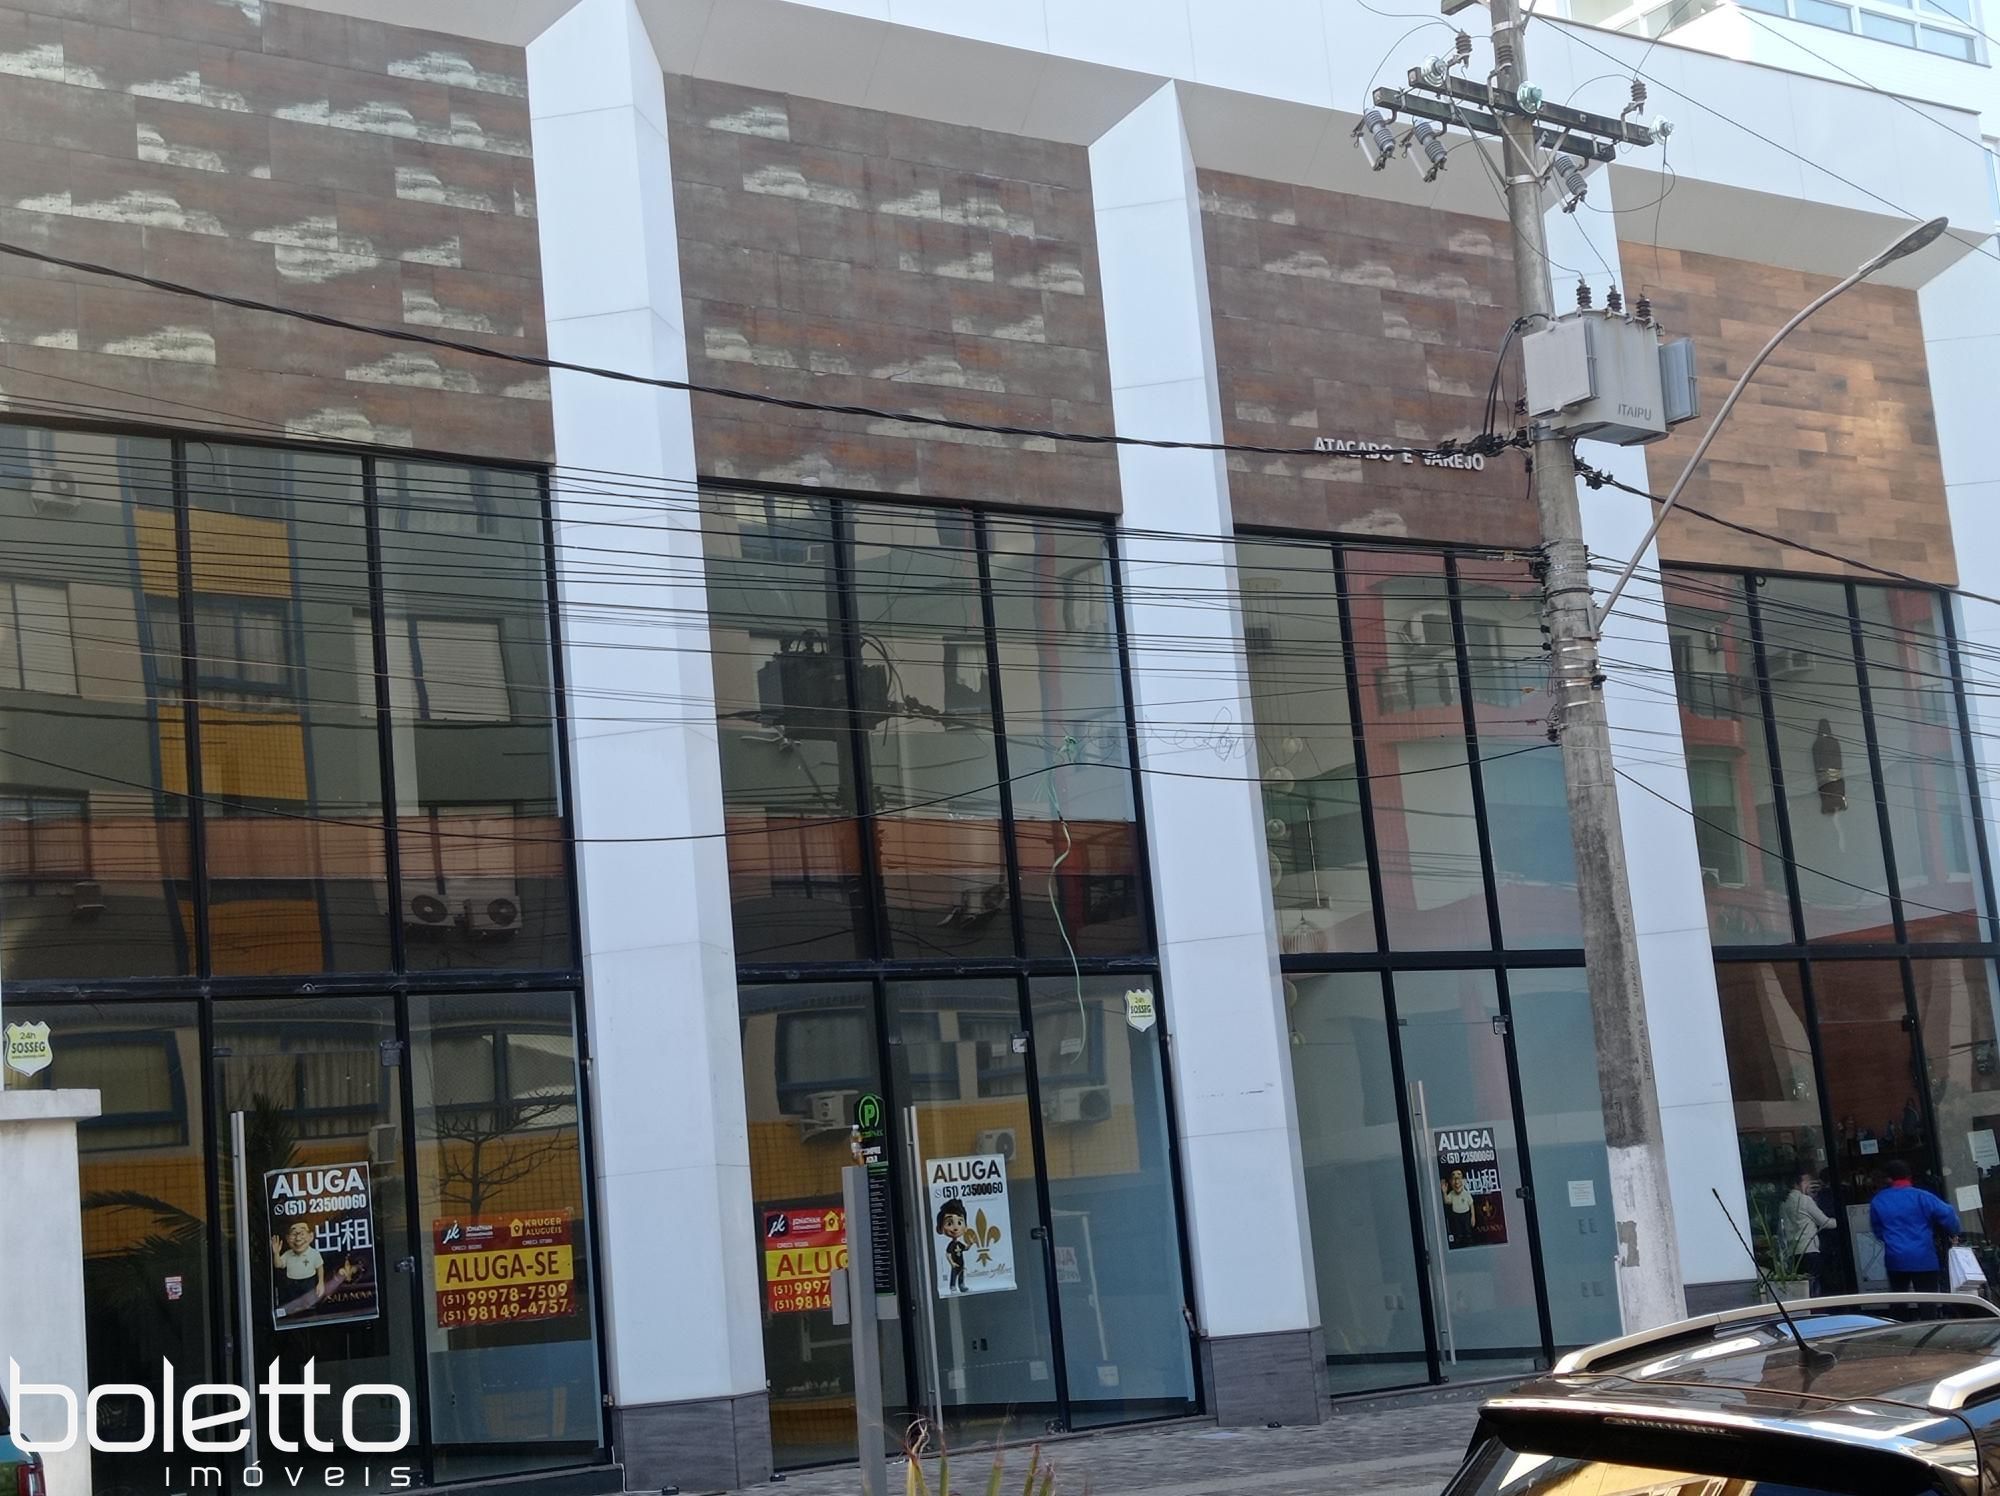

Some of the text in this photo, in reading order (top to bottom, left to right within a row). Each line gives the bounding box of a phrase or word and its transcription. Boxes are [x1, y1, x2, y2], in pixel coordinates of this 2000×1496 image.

[1618, 404, 1651, 421] ITAIPU
[1314, 436, 1484, 471] ATACADO E VAREJO
[19, 1032, 36, 1040] 24h
[11, 1041, 45, 1054] SOSSEG
[1438, 1130, 1493, 1151] ALUGA
[933, 1160, 1001, 1184] ALUGA
[272, 1168, 365, 1199] ALUGA
[943, 1182, 1003, 1198] (51) 23500060
[284, 1194, 367, 1215] (51) 23500060
[525, 1217, 562, 1227] KRUGER
[315, 1218, 373, 1252] 出租
[446, 1251, 560, 1284] ALUGA-SE
